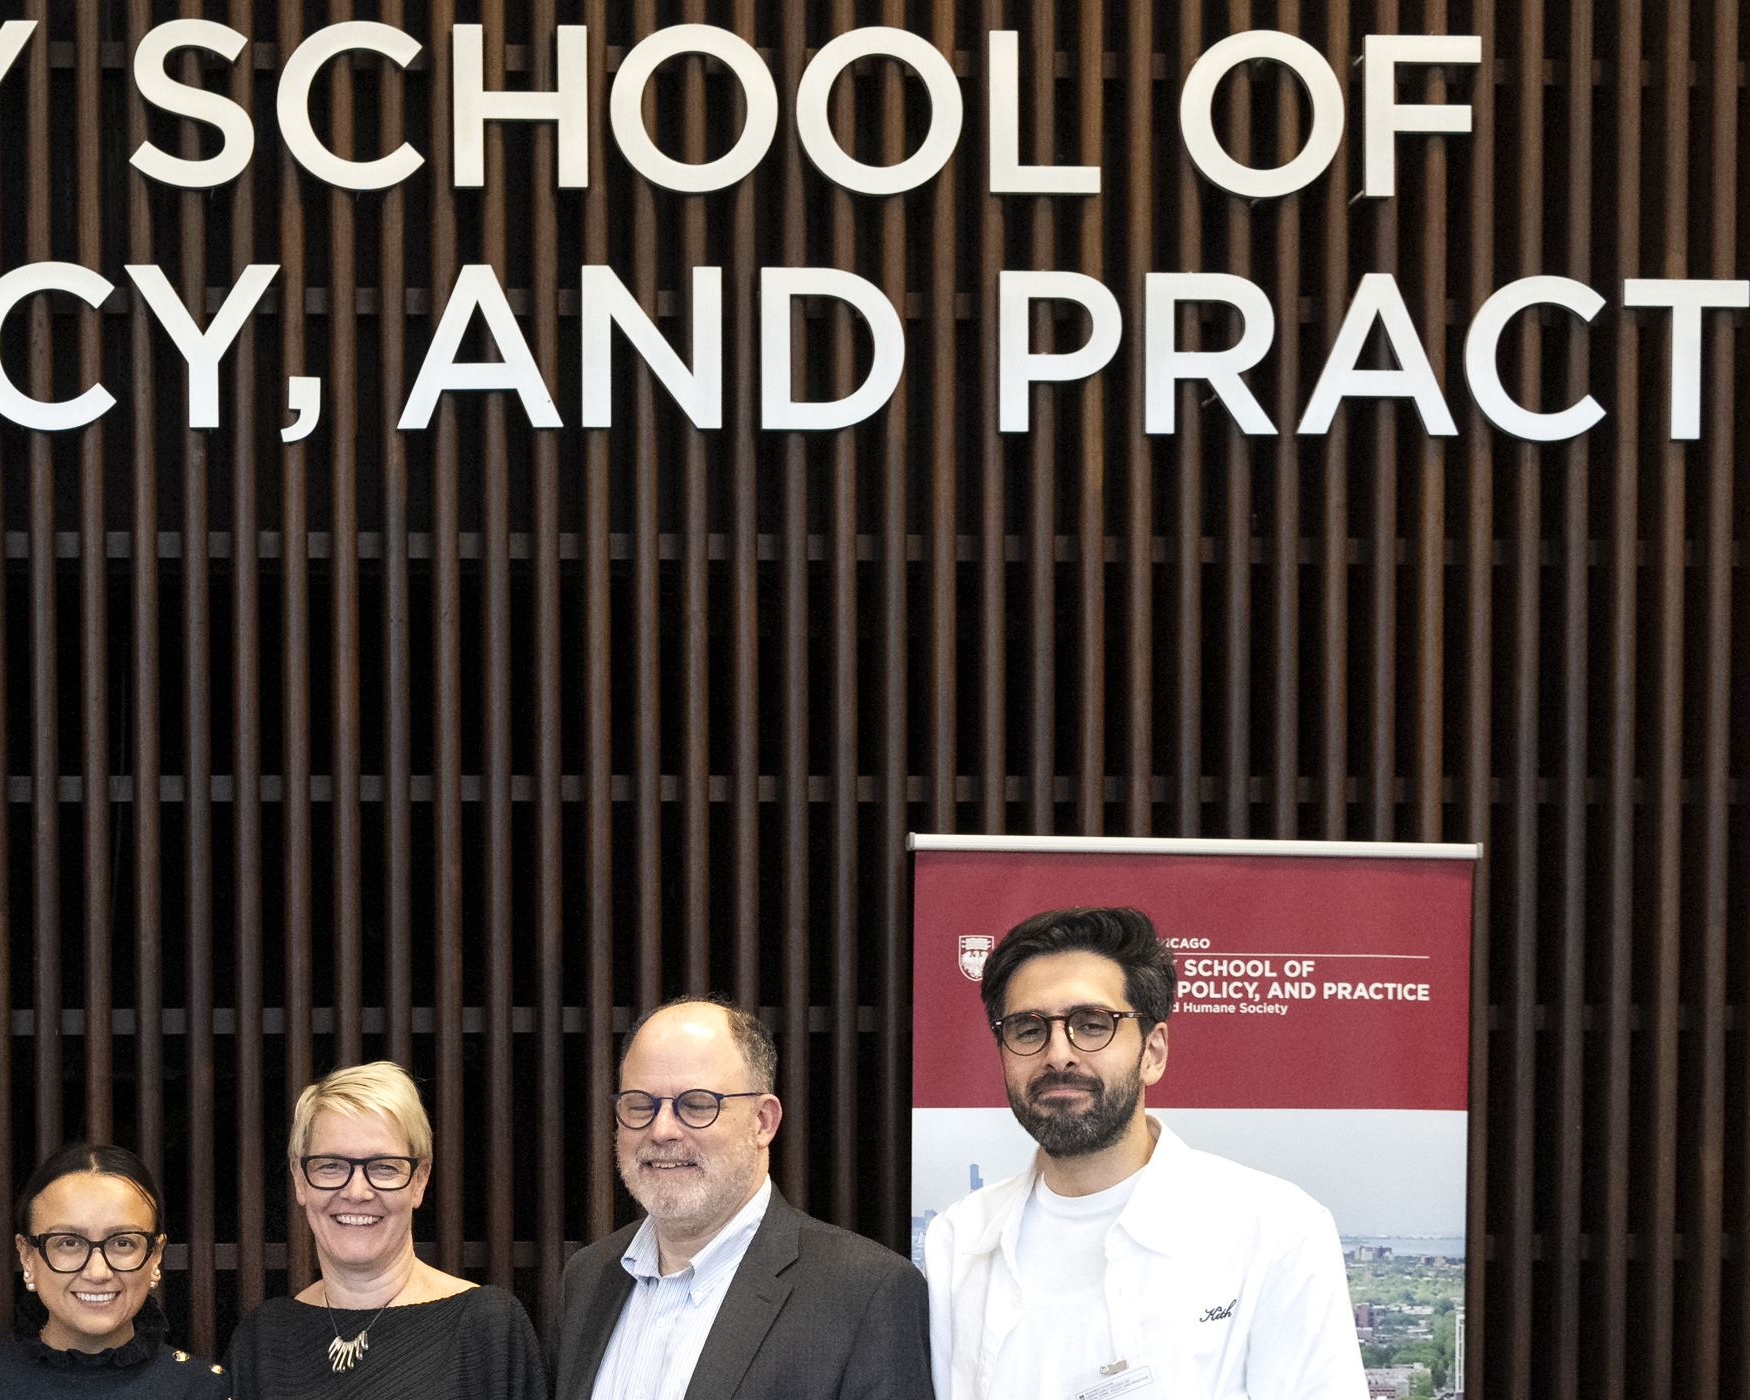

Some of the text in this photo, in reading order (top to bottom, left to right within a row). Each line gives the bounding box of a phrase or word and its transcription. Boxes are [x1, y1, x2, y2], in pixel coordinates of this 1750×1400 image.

[129, 18, 1101, 194] SCHOOL
[1180, 30, 1482, 198] OF
[397, 264, 905, 429] AND
[999, 270, 1750, 441] PRACT
[1184, 958, 1316, 978] SCHOOL OF
[1175, 980, 1430, 1004] POLICY, AND PRACTICE
[1183, 1001, 1237, 1014] Humane
[1239, 1002, 1289, 1016] Society
